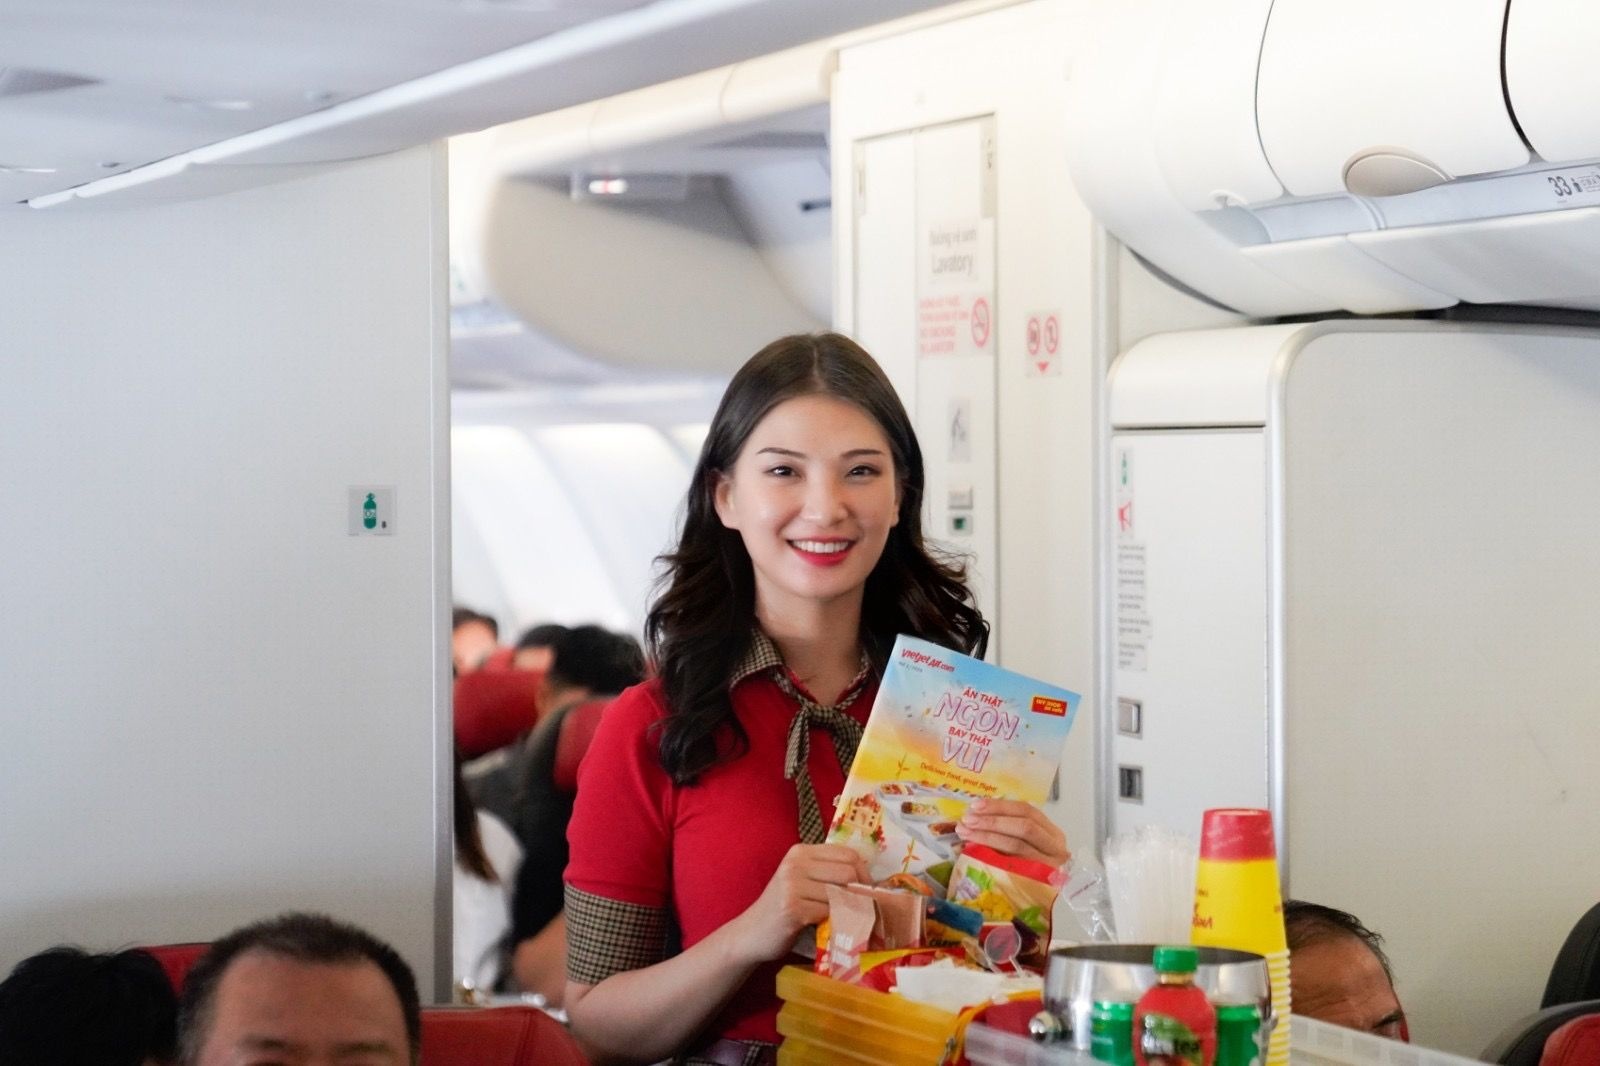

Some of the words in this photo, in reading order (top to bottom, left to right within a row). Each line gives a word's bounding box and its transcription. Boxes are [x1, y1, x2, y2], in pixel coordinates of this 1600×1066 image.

[1547, 175, 1573, 197] 33
[933, 691, 1020, 741] NGON
[948, 726, 968, 739] BAY
[943, 735, 991, 774] VUI
